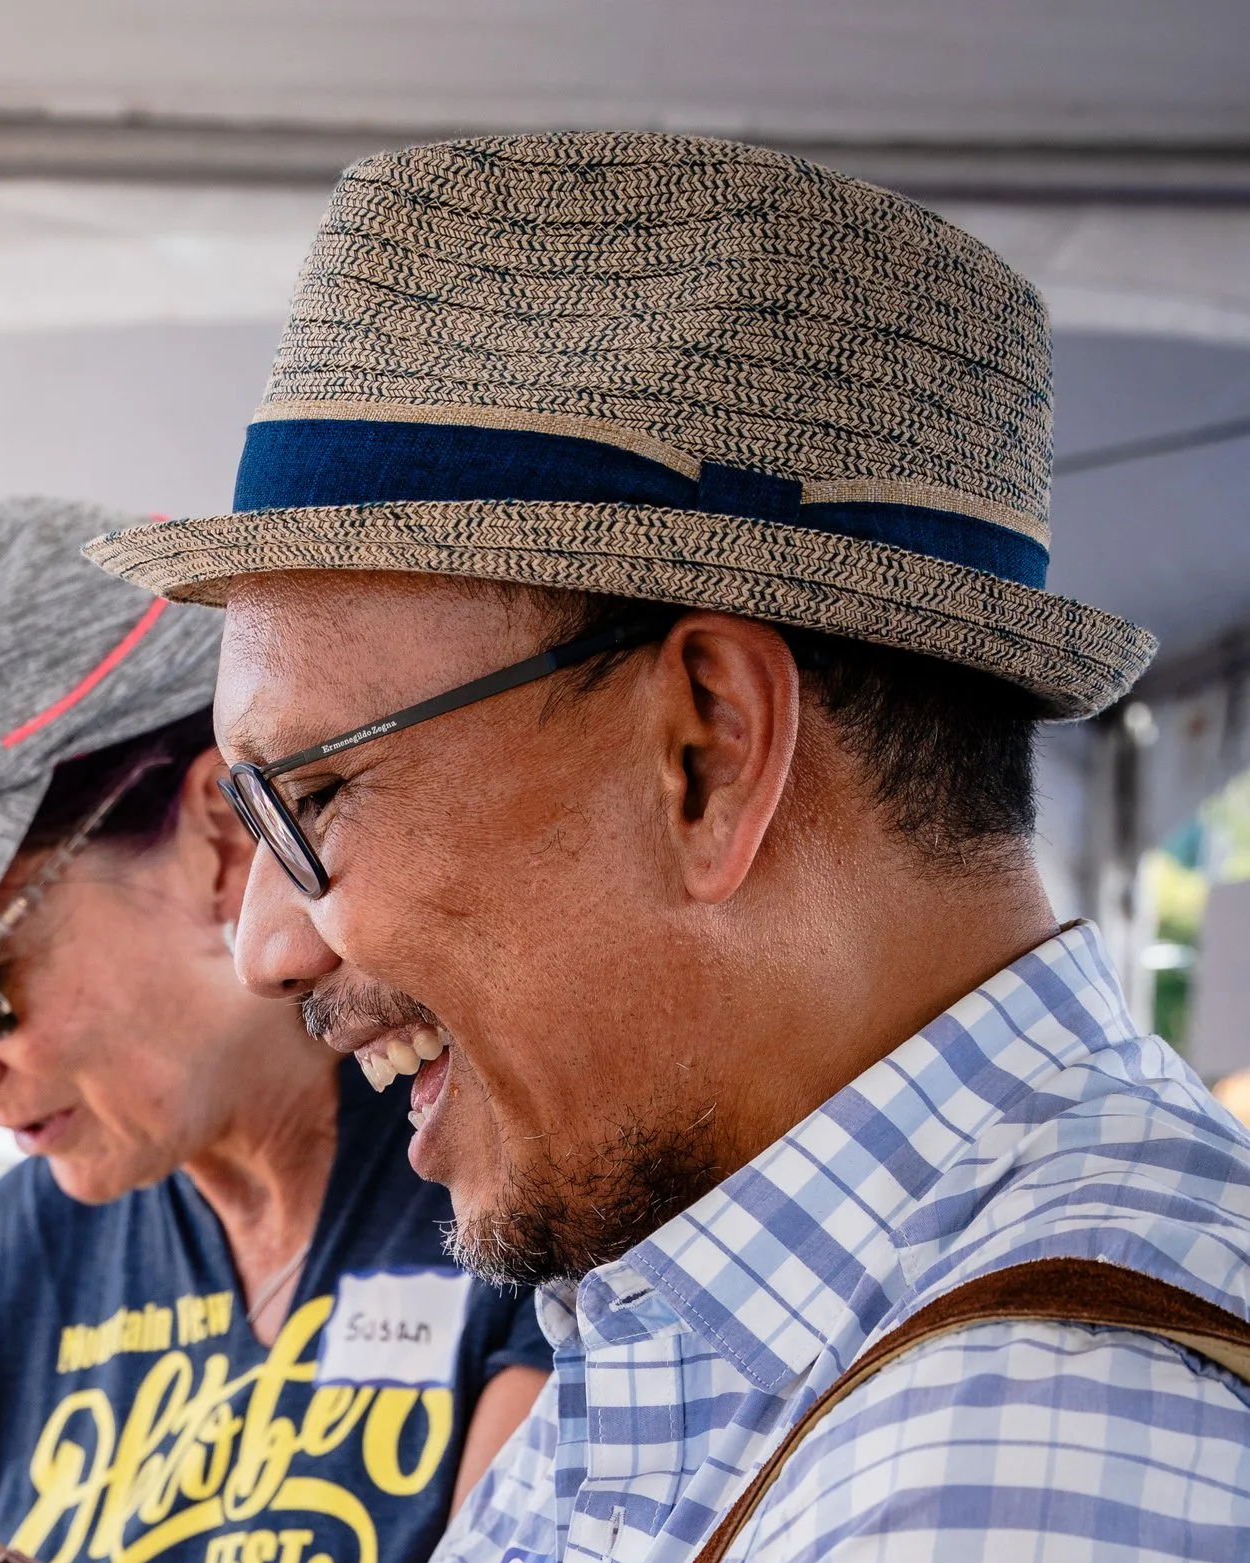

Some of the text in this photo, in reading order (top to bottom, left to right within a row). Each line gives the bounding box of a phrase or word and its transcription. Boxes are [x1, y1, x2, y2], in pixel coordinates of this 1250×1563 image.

[321, 720, 398, 754] Ermenegildo Zegna
[344, 1311, 432, 1344] Susan
